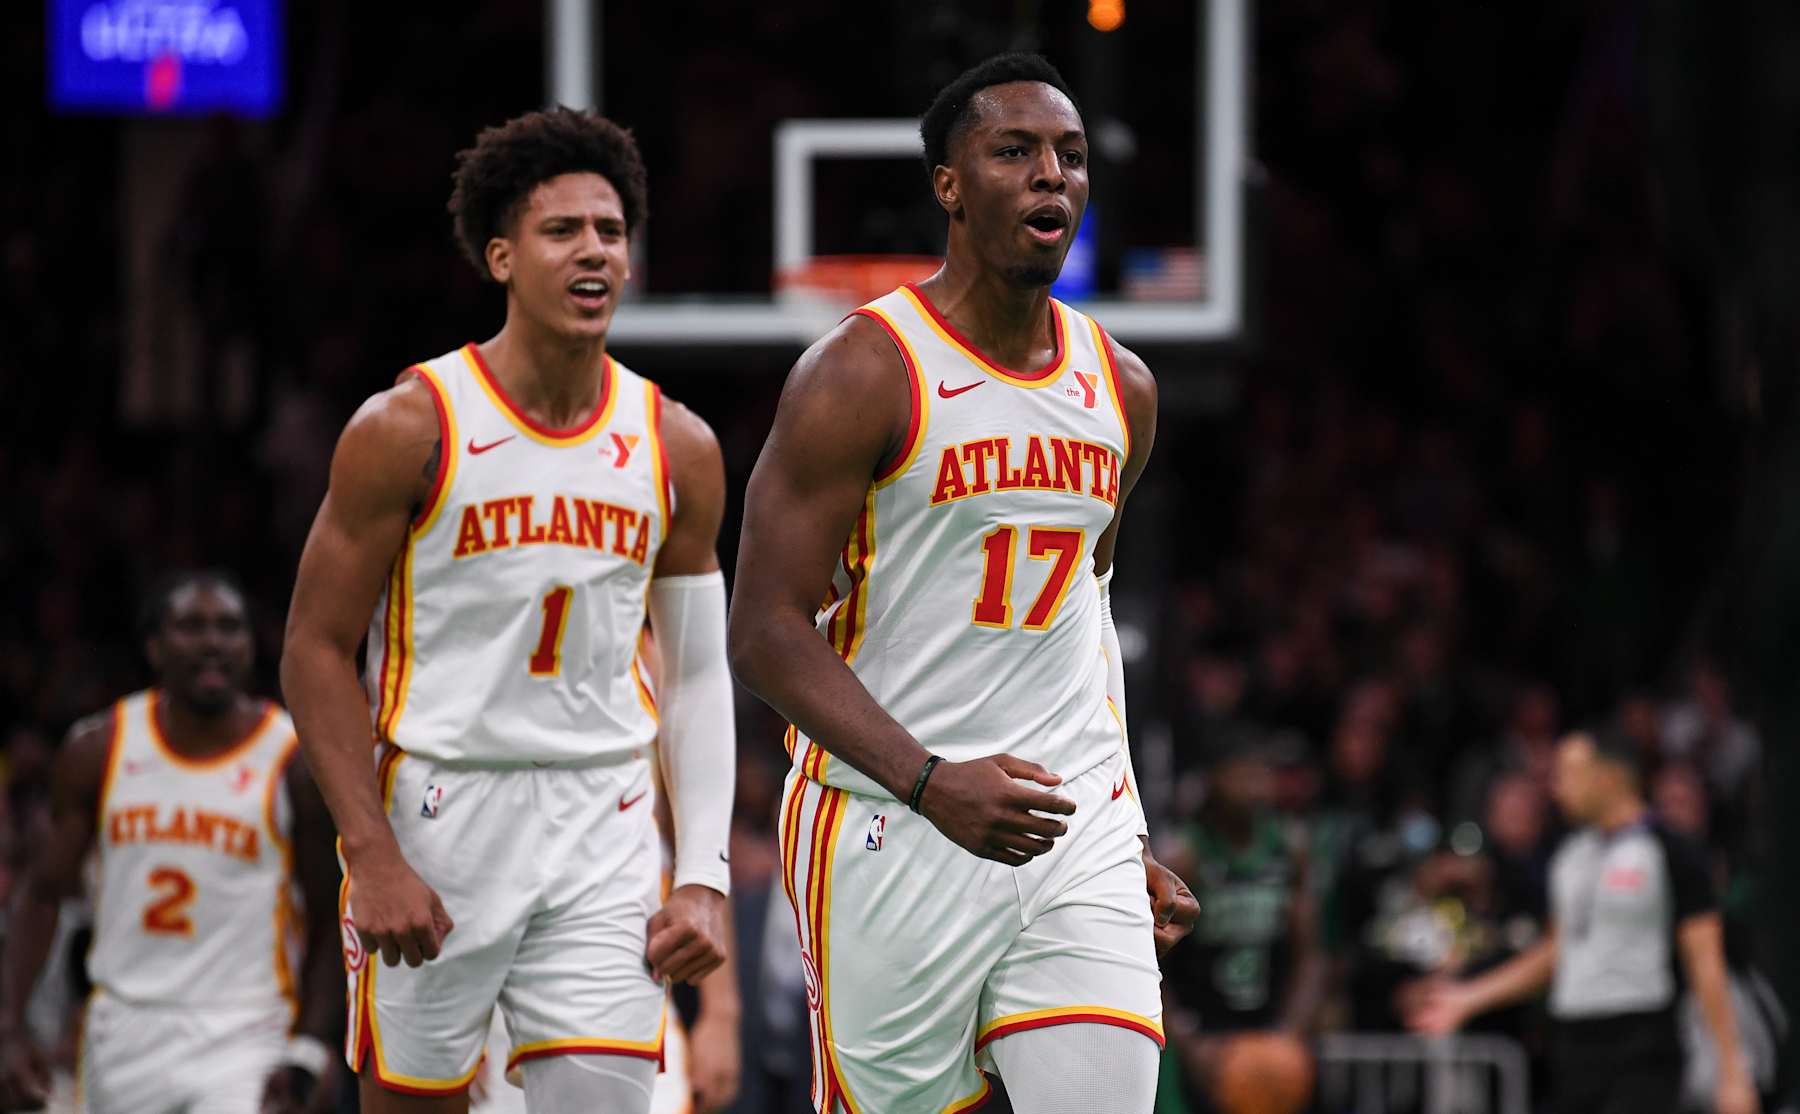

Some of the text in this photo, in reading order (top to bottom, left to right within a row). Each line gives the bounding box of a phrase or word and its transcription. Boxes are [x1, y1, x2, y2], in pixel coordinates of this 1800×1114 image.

[1065, 387, 1081, 398] the
[929, 433, 1120, 508] ATLANTA
[453, 494, 650, 567] ATLANTA
[970, 523, 1085, 631] 17
[528, 584, 574, 677] 1
[108, 803, 260, 864] ATLANTA
[142, 865, 197, 938] 2
